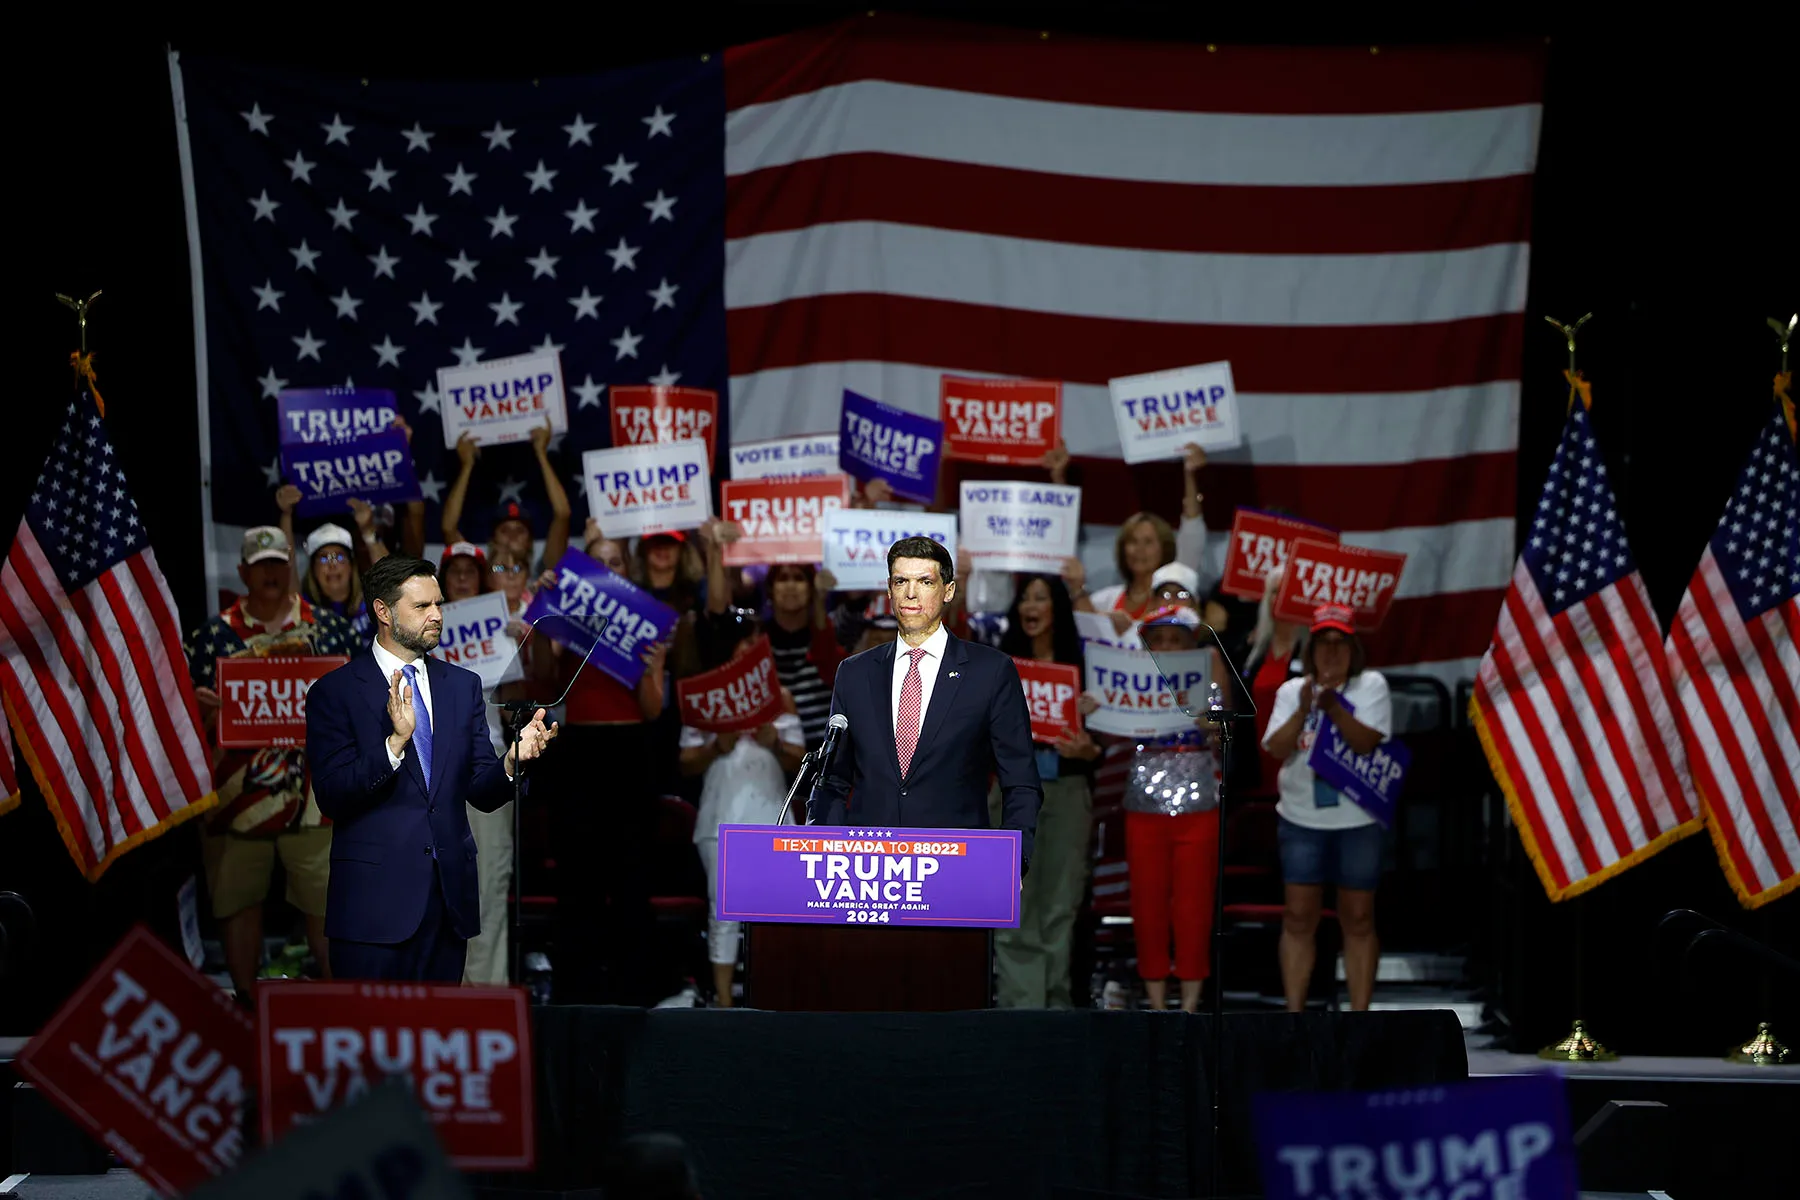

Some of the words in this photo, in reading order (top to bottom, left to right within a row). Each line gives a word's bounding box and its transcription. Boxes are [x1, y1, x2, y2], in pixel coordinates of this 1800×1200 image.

[449, 373, 553, 406] TRUMP
[1123, 385, 1225, 418] TRUMP
[286, 407, 396, 432] TRUMP
[463, 393, 545, 420] VANCE
[616, 405, 712, 429] TRUMP
[946, 397, 1054, 422] TRUMP
[1138, 406, 1218, 432] VANCE
[845, 410, 934, 455] TRUMP
[956, 418, 1041, 439] VANCE
[292, 450, 403, 482] TRUMP
[735, 446, 783, 465] VOTE
[789, 443, 839, 458] EARL
[851, 434, 921, 472] VANCE
[309, 470, 396, 493] VANCE
[594, 463, 700, 493] TRUMP
[607, 483, 691, 508] VANCE
[965, 488, 1012, 503] VOTE
[1018, 488, 1075, 507] EARLY
[1237, 531, 1289, 560] TRU
[1295, 558, 1395, 591] TRUMP
[558, 568, 659, 641] TRUMP
[1302, 579, 1379, 607] VANCE
[439, 618, 501, 647] UMP
[559, 592, 638, 653] VANCE
[430, 640, 495, 662] NCE
[225, 679, 317, 701] TRUM
[685, 657, 772, 709] TRUMP
[1092, 665, 1202, 692] TRUMP
[238, 700, 306, 718] VANC
[700, 682, 770, 719] VANCE
[1103, 689, 1190, 708] VANCE
[1333, 736, 1391, 795] VANCE
[781, 839, 818, 851] TEXT
[822, 840, 885, 853] NEVADA
[889, 842, 909, 854] TO
[912, 842, 959, 855] 88022
[800, 854, 939, 881] TRUMP
[814, 880, 923, 902] VANCE
[846, 910, 890, 923] 2024
[871, 902, 898, 910] GREAT
[900, 903, 930, 911] AGAIN!
[101, 968, 245, 1120] TRUM
[273, 1026, 518, 1076] TRUMP
[304, 1070, 493, 1112] VACE
[1276, 1120, 1555, 1197] TRUMP
